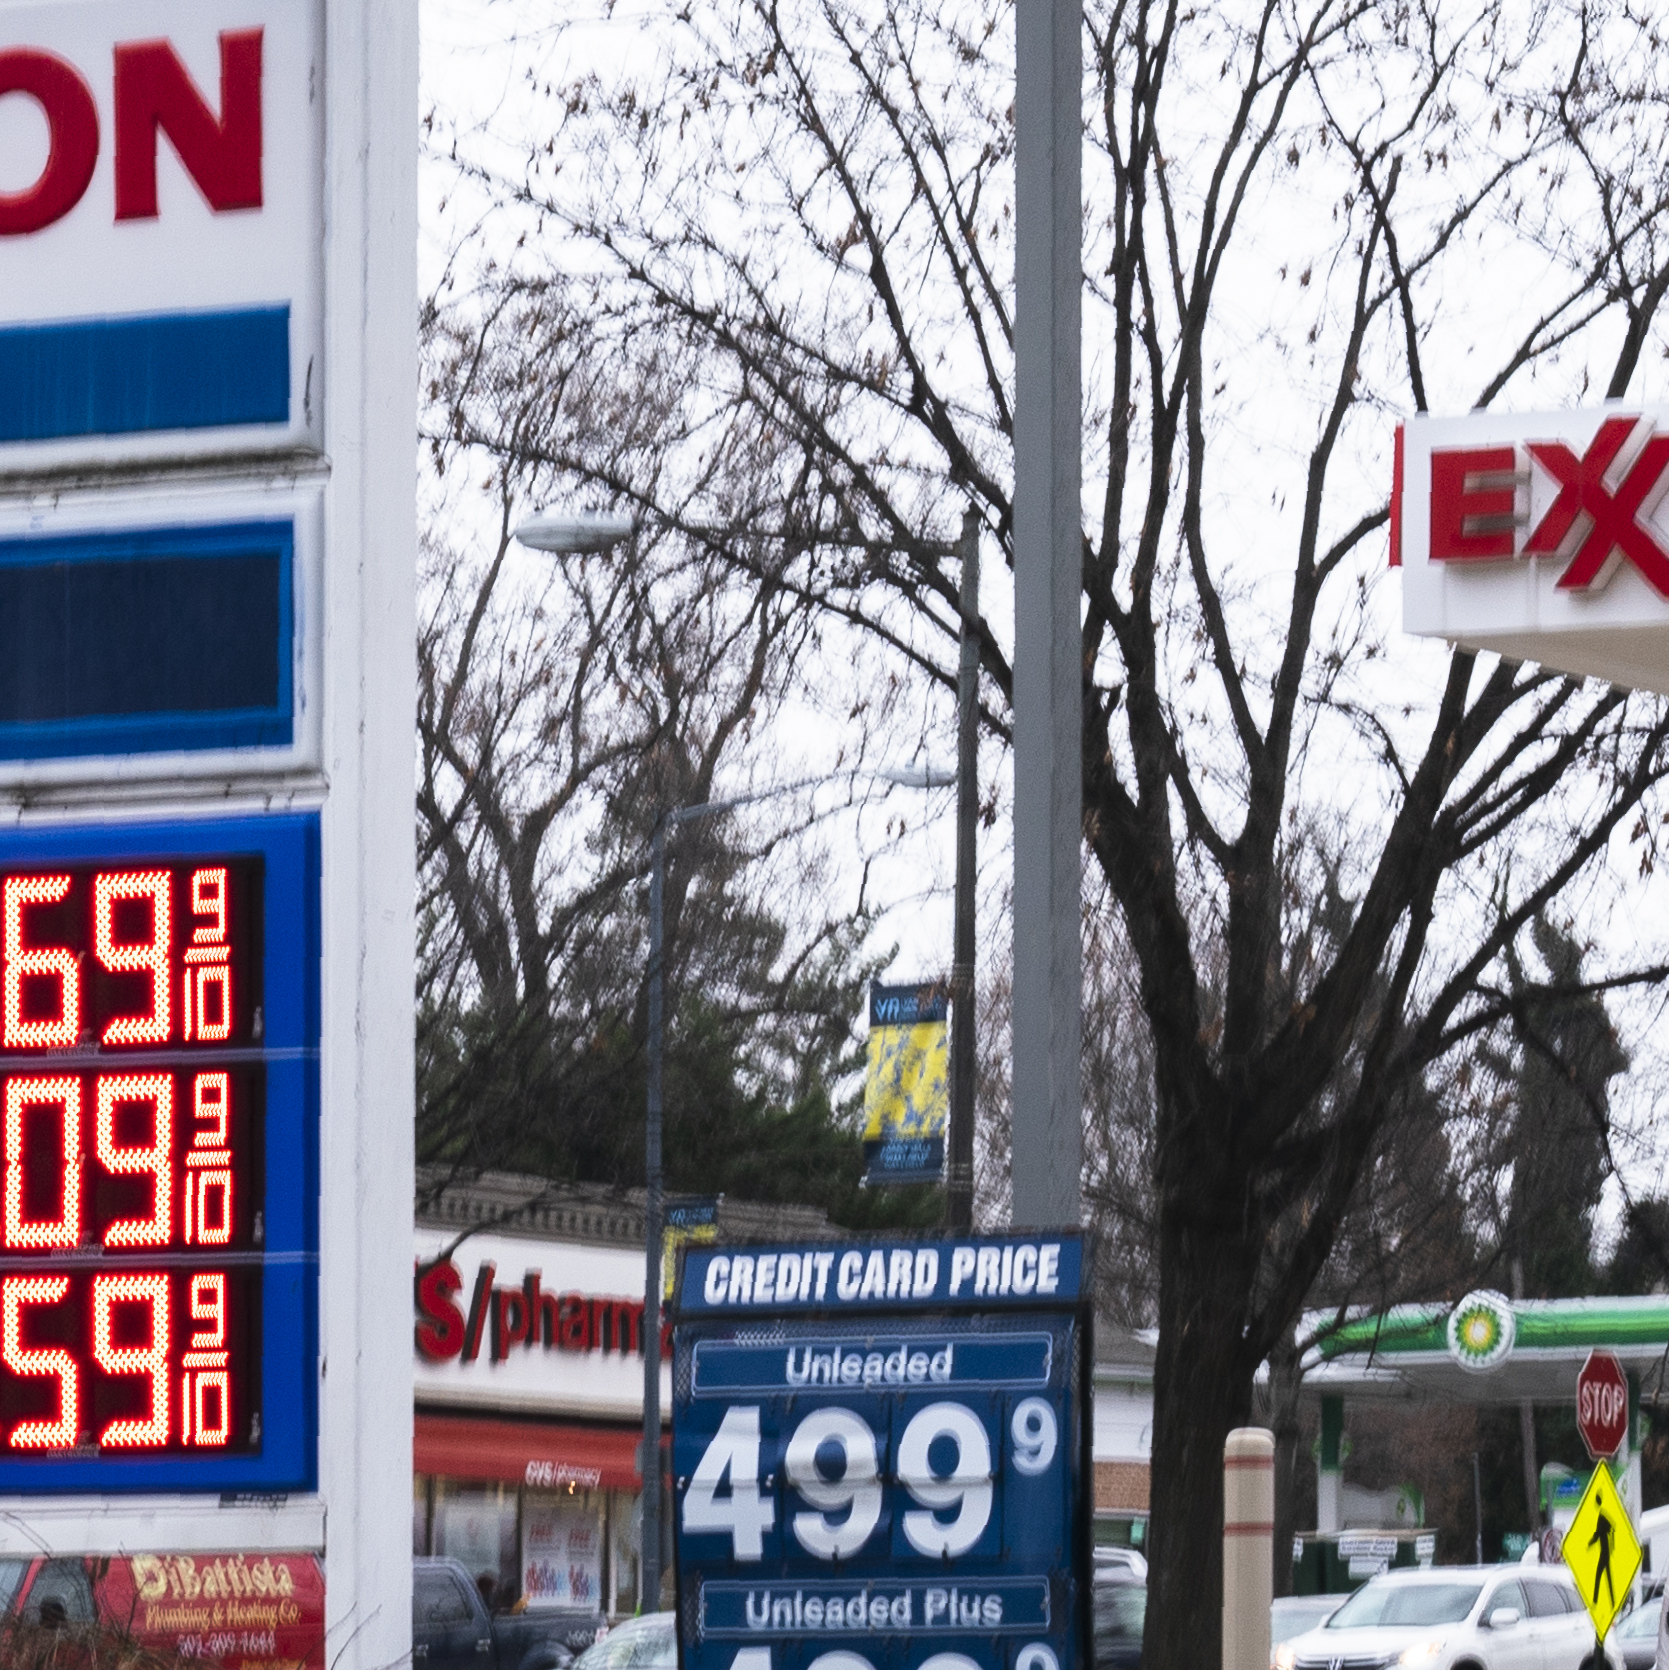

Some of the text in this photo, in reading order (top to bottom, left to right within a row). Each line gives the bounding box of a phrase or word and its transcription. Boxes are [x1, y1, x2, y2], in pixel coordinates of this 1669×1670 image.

[703, 1243, 1061, 1306] CREDIT CARD PRICE
[784, 1343, 955, 1385] Unleaded
[1581, 1380, 1625, 1428] STOP
[682, 1397, 1059, 1562] 499 9
[131, 1553, 296, 1600] DiBattista
[146, 1602, 210, 1633] Plumbing
[212, 1600, 224, 1628] &
[226, 1599, 277, 1631] Heating
[744, 1587, 1003, 1629] Unleaded Plus
